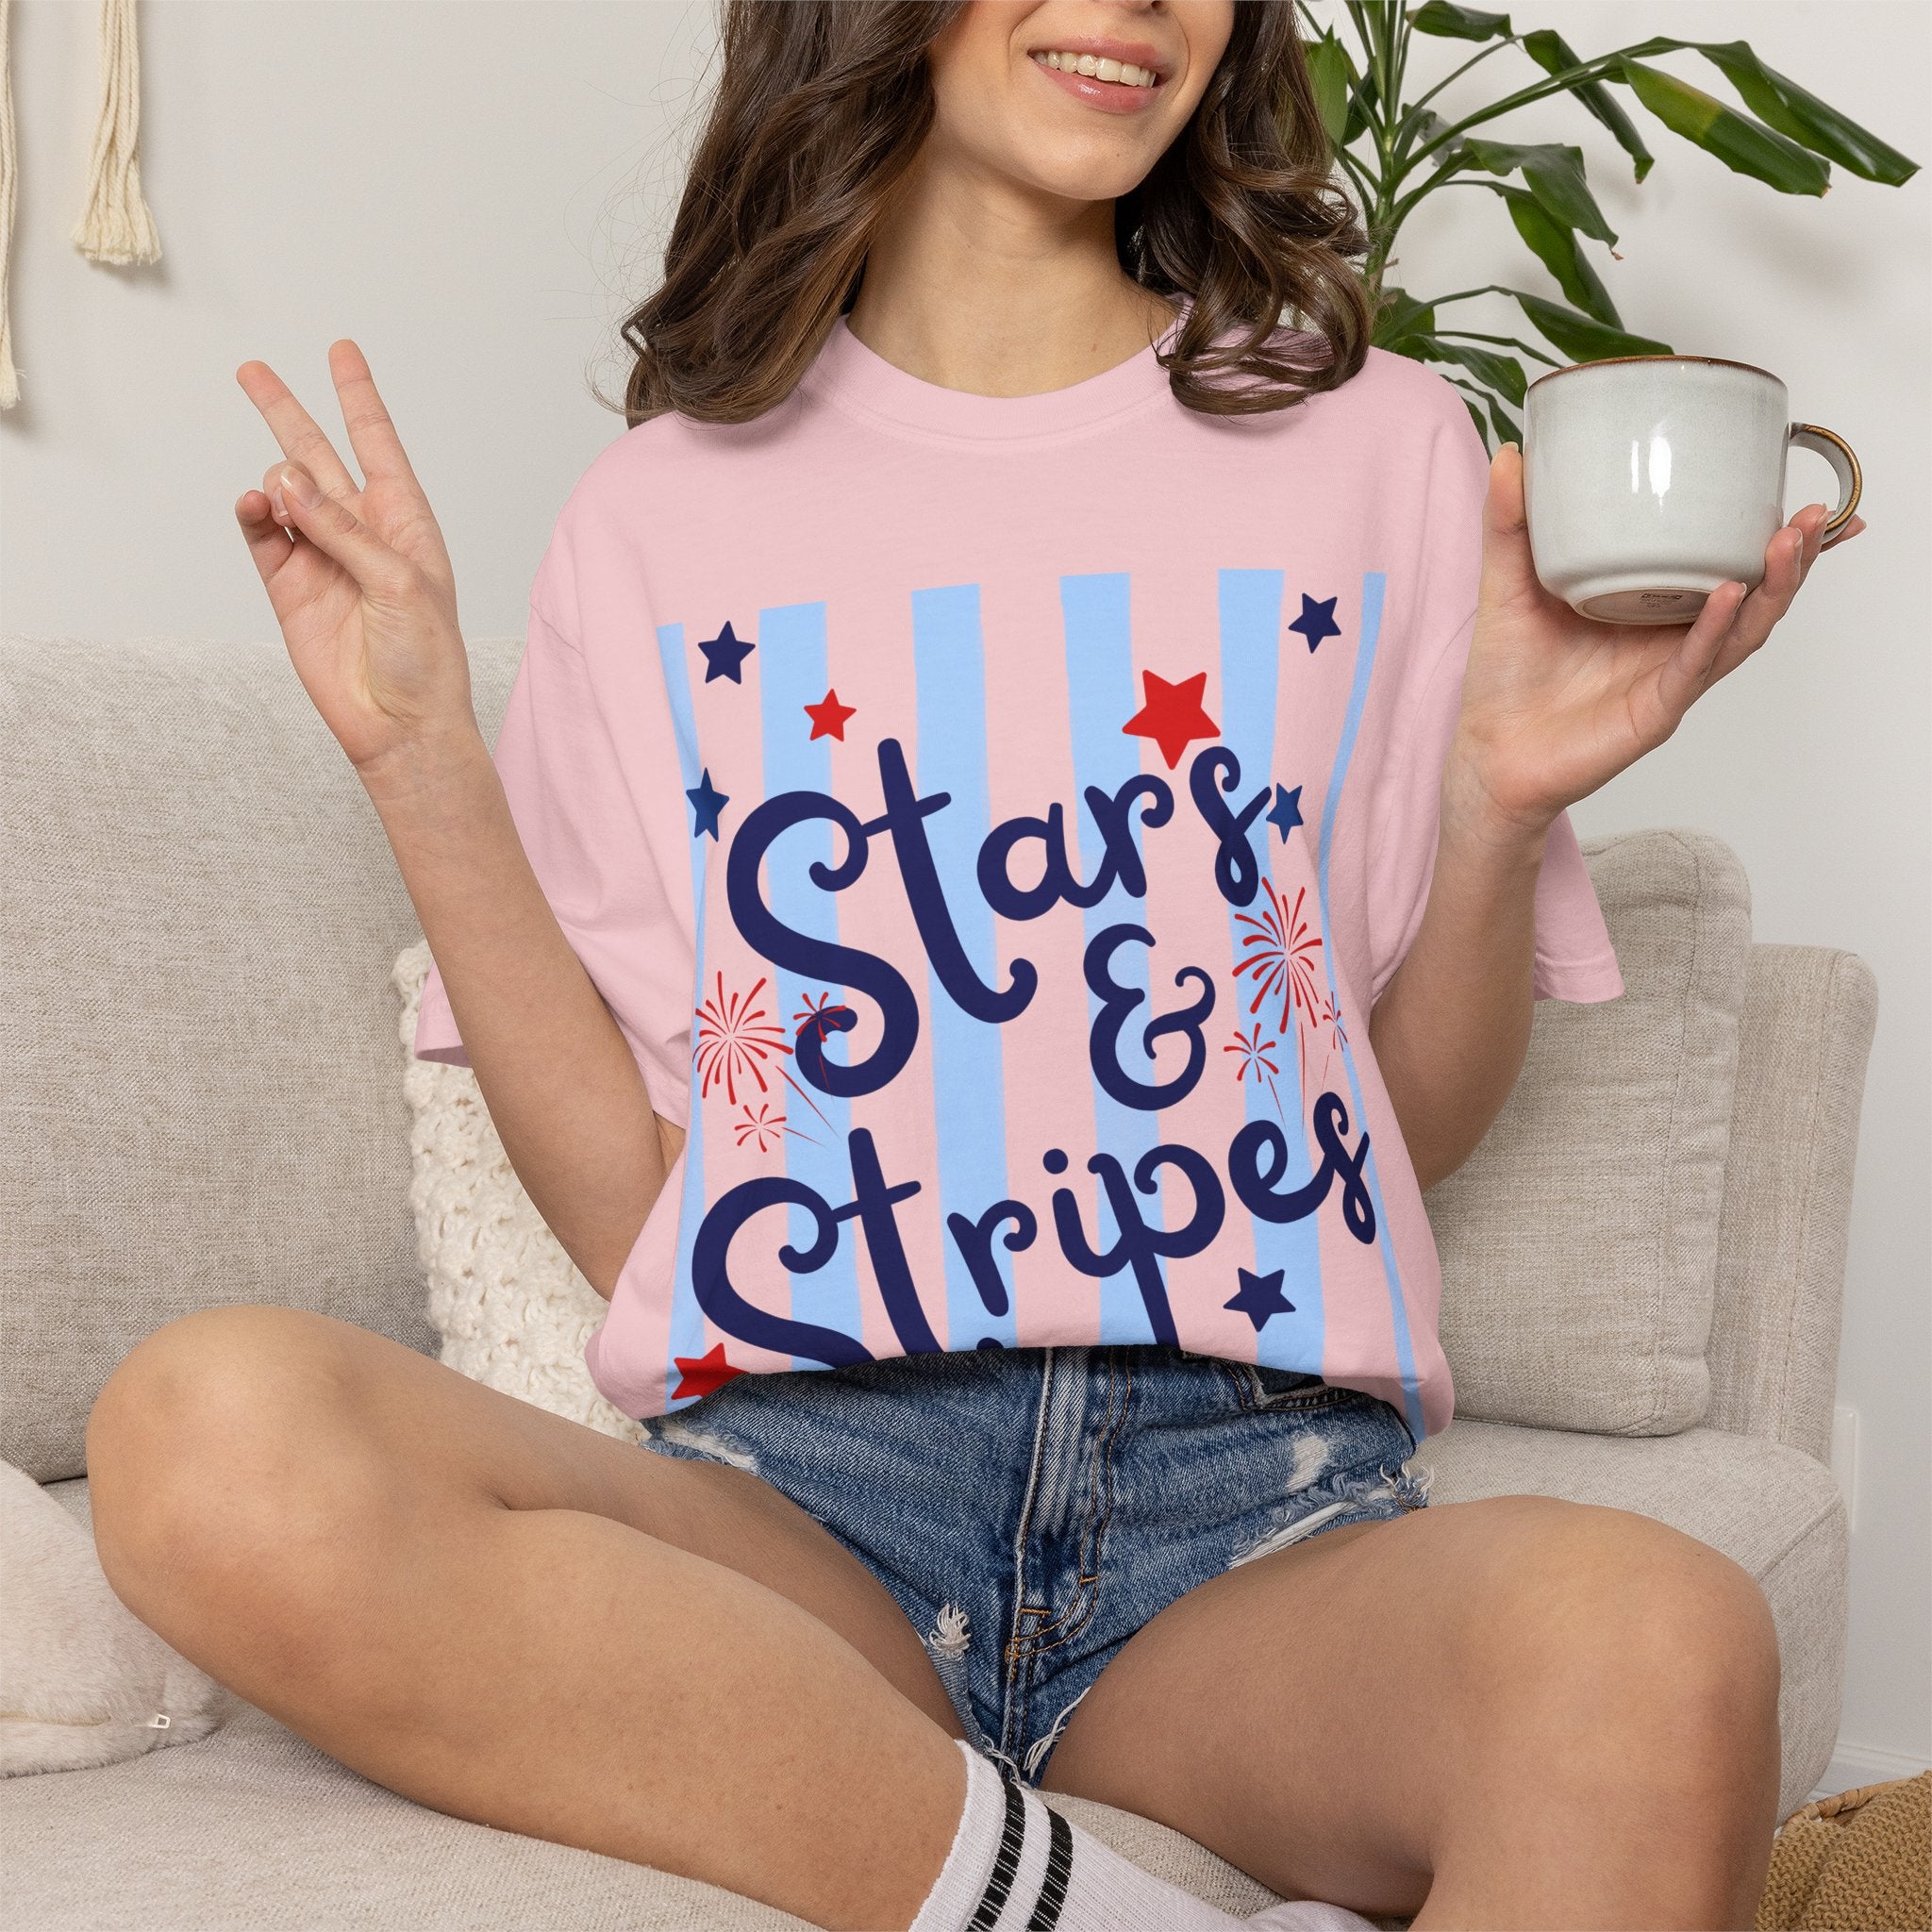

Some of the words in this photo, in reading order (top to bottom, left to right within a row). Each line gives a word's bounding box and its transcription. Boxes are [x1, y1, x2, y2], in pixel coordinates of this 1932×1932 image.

[726, 739, 1272, 1098] Stars
[1083, 924, 1216, 1111] &
[691, 1092, 1376, 1368] Stripes
